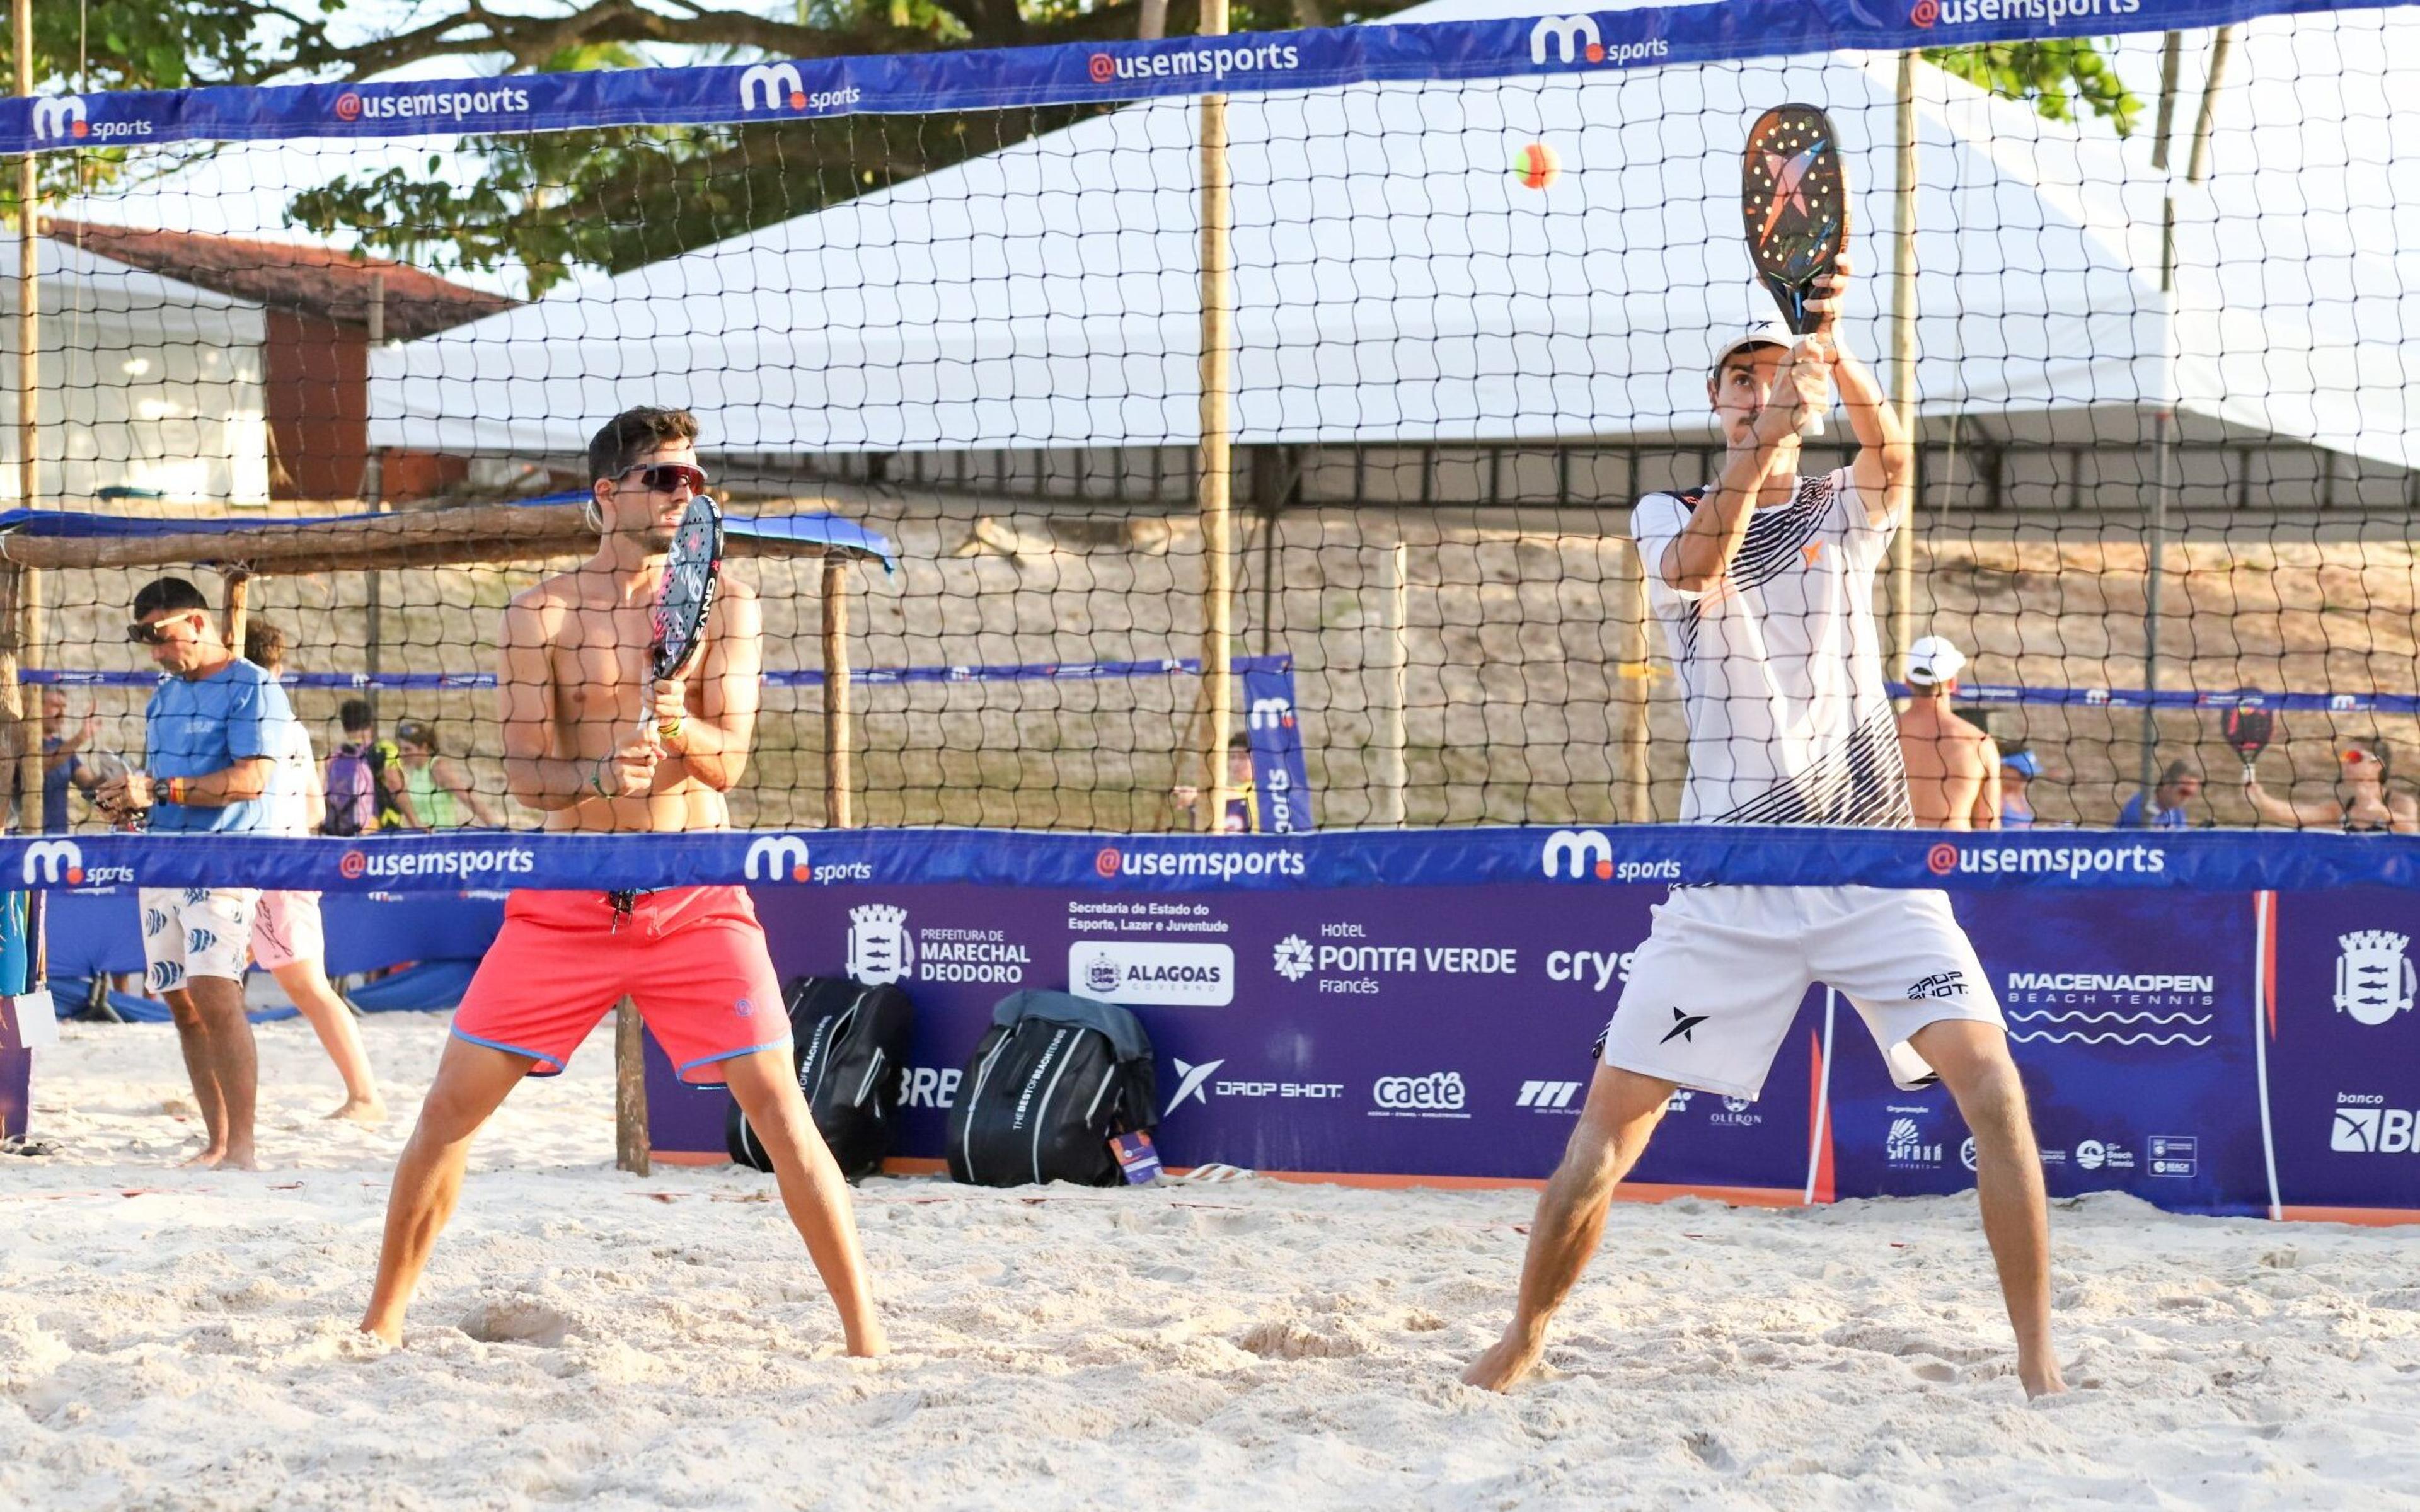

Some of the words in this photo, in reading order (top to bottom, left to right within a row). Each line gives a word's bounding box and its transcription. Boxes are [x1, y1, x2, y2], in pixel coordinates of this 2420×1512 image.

[1608, 37, 1668, 65] sports
[1090, 42, 1298, 84] @usemsports
[336, 86, 529, 121] @usemsports
[809, 86, 860, 112] sports
[92, 119, 152, 139] sports
[340, 848, 533, 879] @usemsports
[1096, 847, 1305, 881] @usemsports
[1617, 858, 1680, 883] sports
[1928, 843, 2165, 878] @usemsports
[86, 864, 134, 884] sports
[814, 861, 871, 884] sports
[1069, 902, 1128, 914] Secretaria
[1131, 903, 1146, 914] de
[1149, 903, 1190, 915] Estado
[1194, 904, 1209, 915] do
[921, 929, 986, 941] PREFEITURA
[989, 930, 1004, 941] DE
[1069, 918, 1117, 932] Esporte,
[1121, 919, 1153, 931] Lazer
[1156, 922, 1163, 931] e
[1166, 920, 1228, 932] Juventude
[1322, 922, 1366, 937] Hotel
[921, 942, 1031, 963] MARECHAL
[1320, 946, 1416, 971] PONTA
[1424, 948, 1517, 973] VERDE
[921, 963, 1022, 983] DEODORO
[1127, 965, 1221, 982] ALAGOAS
[2008, 973, 2213, 992] MACENAOPEN
[1132, 983, 1216, 992] GOVERNO
[1320, 978, 1379, 994] Francês
[2008, 993, 2095, 1004] BEACH
[2112, 995, 2213, 1005] TENNIS
[1216, 1081, 1277, 1096] DROP
[1376, 1074, 1463, 1106] caeté
[2337, 1092, 2383, 1104] banco
